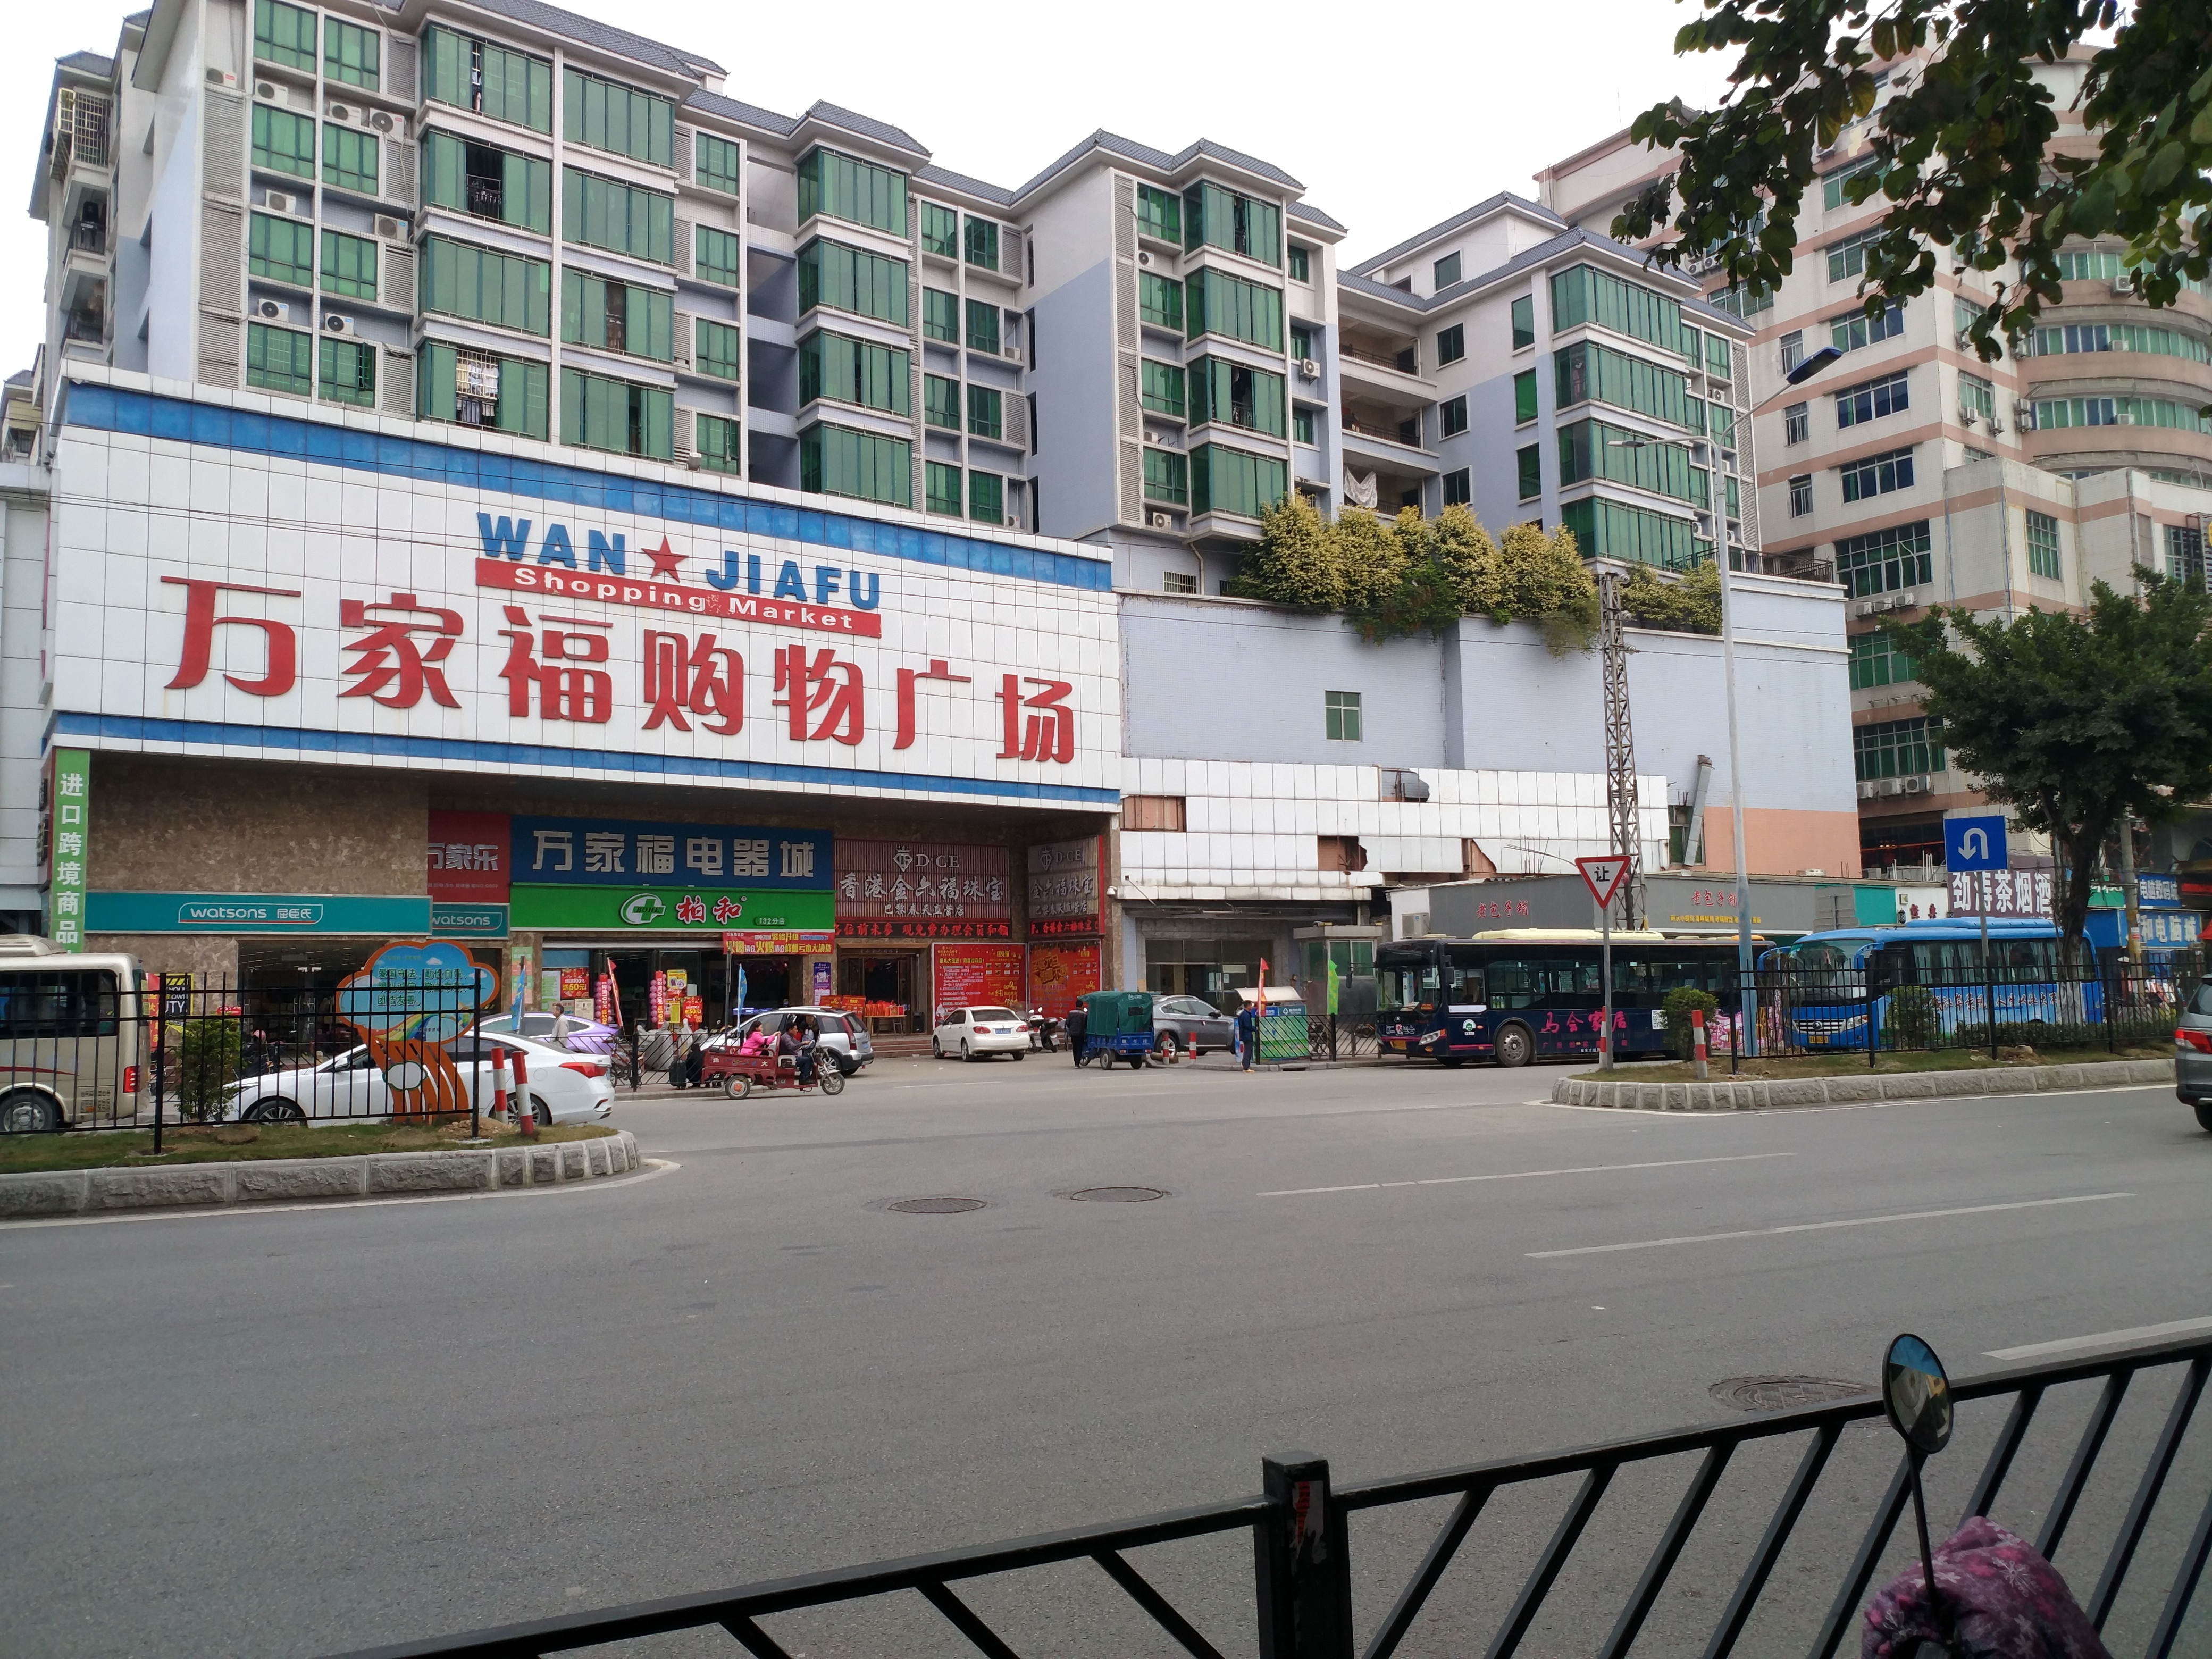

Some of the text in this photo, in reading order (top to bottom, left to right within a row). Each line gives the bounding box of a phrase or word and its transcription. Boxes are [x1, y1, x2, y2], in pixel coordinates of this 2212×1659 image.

[475, 512, 881, 610] WAN JIAFU
[514, 567, 852, 630] Shopping Market
[160, 575, 1075, 764] 万家福购物广场
[56, 773, 83, 953] 进口跨境商品
[532, 830, 815, 878] 万家福电器城
[840, 872, 1004, 901] 香港金六福珠宝
[1030, 874, 1093, 899] 金六福珠宝
[1594, 866, 1610, 883] 让
[190, 907, 312, 919] watsons 屈臣氏
[676, 895, 742, 925] 柏和
[884, 903, 965, 917] 巴黎春天直营店
[1476, 900, 1529, 918] 老包子铺
